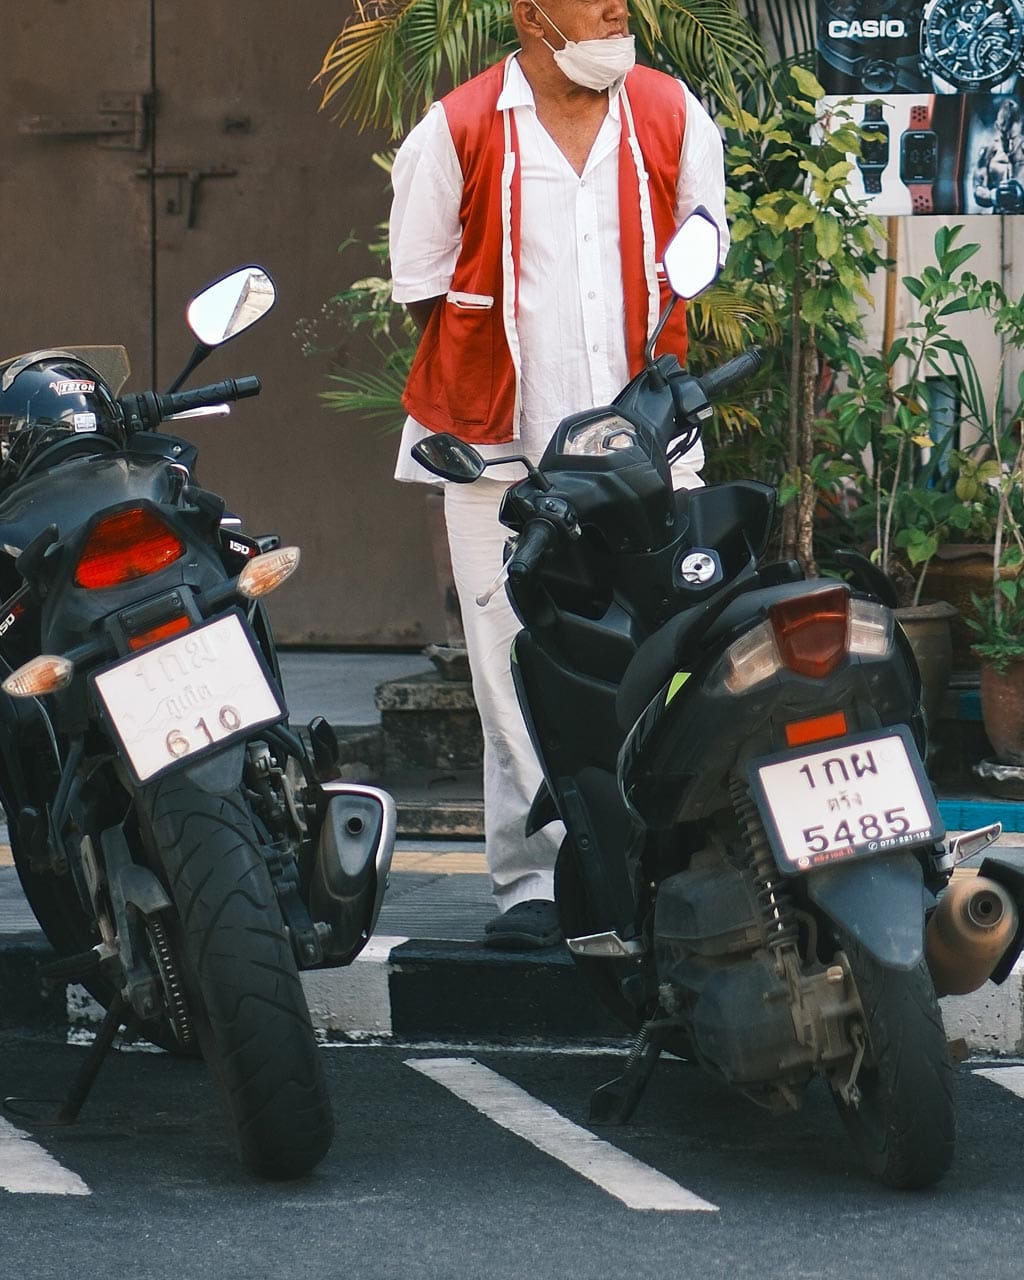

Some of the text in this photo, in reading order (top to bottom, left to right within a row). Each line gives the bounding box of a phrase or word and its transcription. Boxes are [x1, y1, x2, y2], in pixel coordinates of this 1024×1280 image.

[828, 20, 905, 38] CASIO
[166, 704, 242, 759] 610
[800, 749, 878, 789] 1กผ
[803, 806, 911, 853] 5485
